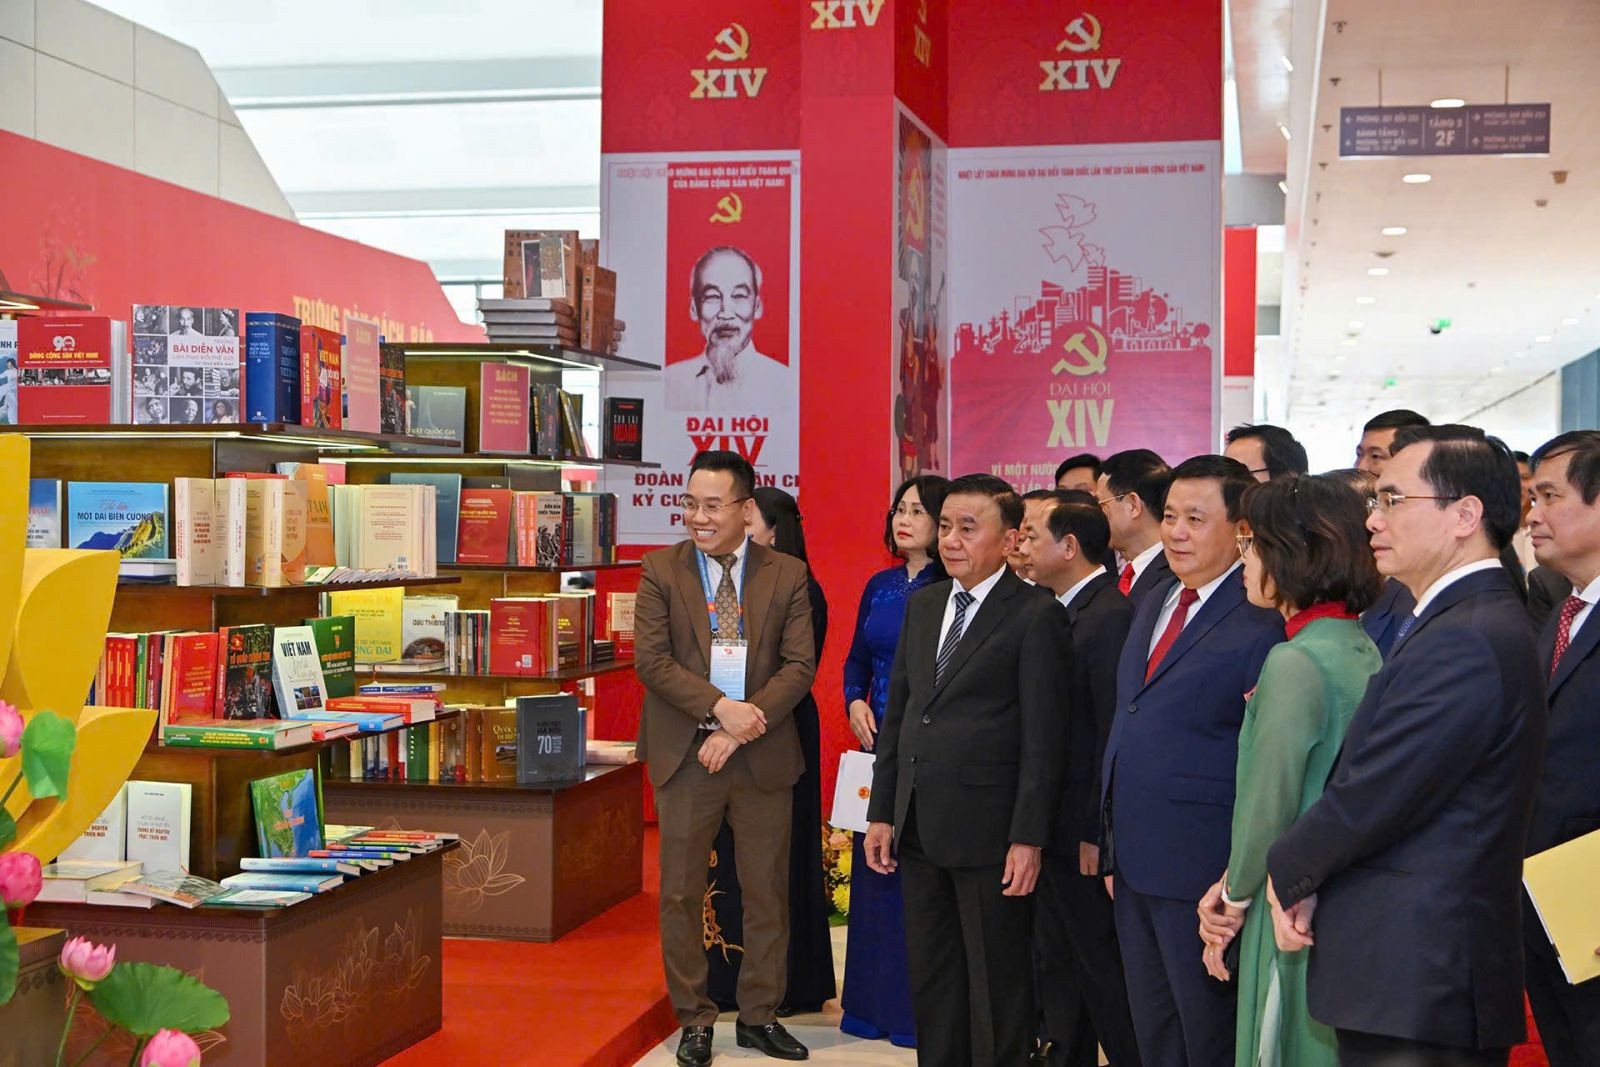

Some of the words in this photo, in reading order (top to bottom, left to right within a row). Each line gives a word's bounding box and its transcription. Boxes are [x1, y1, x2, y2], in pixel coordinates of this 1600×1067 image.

[811, 0, 885, 29] XIV
[690, 67, 768, 99] XIV
[1038, 58, 1121, 92] XIV
[1429, 115, 1456, 128] TẦNG
[1457, 118, 1464, 128] 2
[1435, 131, 1456, 147] 2F
[673, 178, 688, 189] CỦA
[711, 179, 730, 189] CỘNG
[732, 178, 747, 188] SẢN
[749, 178, 763, 189] VIỆT
[46, 352, 61, 360] CỘNG
[173, 343, 189, 353] BÀI
[192, 342, 213, 354] DIỄN
[215, 344, 235, 354] VĂN
[495, 368, 518, 382] SÁCH
[1082, 381, 1112, 397] HỘI
[686, 416, 724, 437] ĐẠI
[731, 414, 769, 437] HỘI
[1046, 399, 1115, 448] XIV
[991, 461, 1001, 476] VÌ
[1004, 461, 1027, 477] MỘT
[634, 471, 683, 487] ĐOÀN
[632, 488, 653, 507] KỶ
[280, 639, 296, 658] VIỆT
[296, 641, 313, 656] NAM
[537, 735, 552, 754] 70
